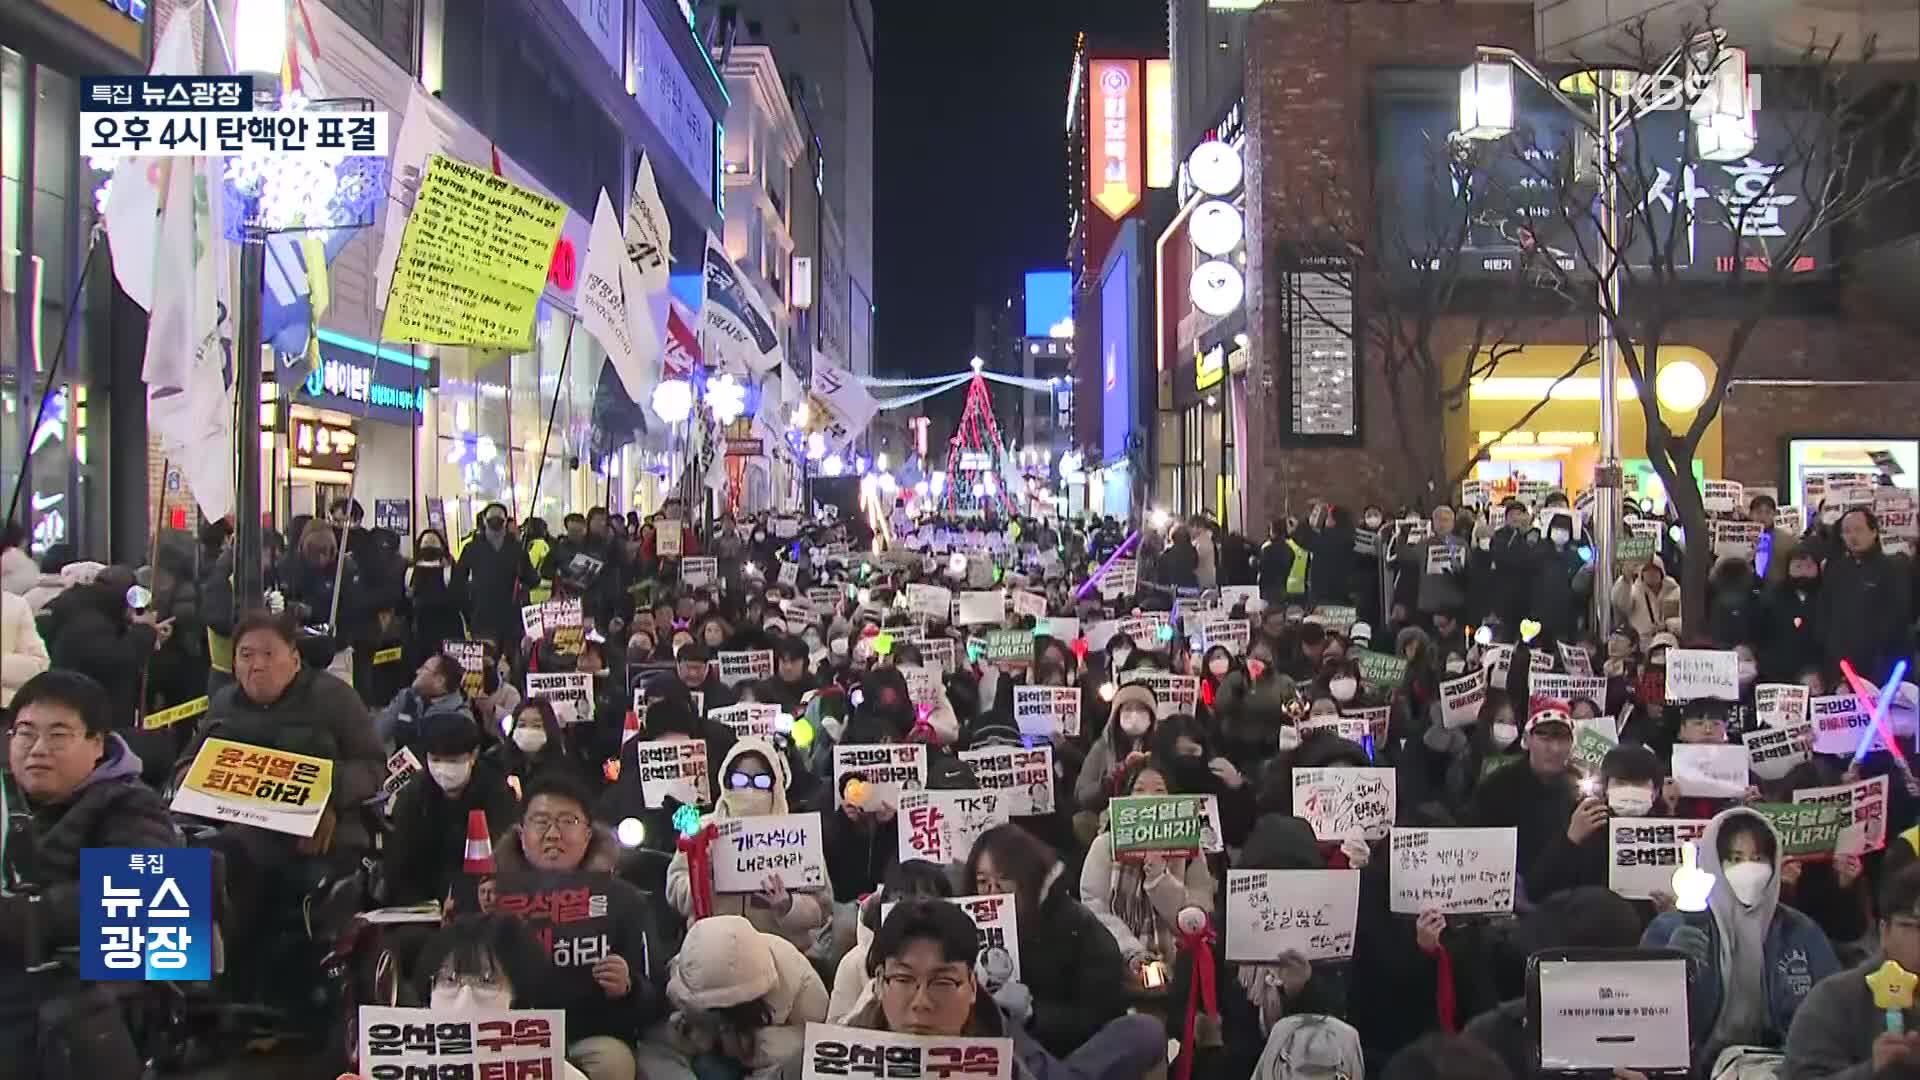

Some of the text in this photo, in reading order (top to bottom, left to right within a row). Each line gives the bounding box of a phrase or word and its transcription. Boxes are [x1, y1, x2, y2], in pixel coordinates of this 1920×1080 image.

[216, 747, 320, 784] 윤석열은
[202, 769, 311, 806] 퇴진하라
[1119, 800, 1197, 827] 윤석열을
[732, 829, 807, 851] 개자식아
[1616, 825, 1674, 843] 윤석열
[738, 852, 803, 873] 내려와라
[1617, 847, 1676, 866] 윤석열
[368, 1019, 551, 1056] 윤석열 구속
[814, 1041, 1000, 1079] 윤석열 구속
